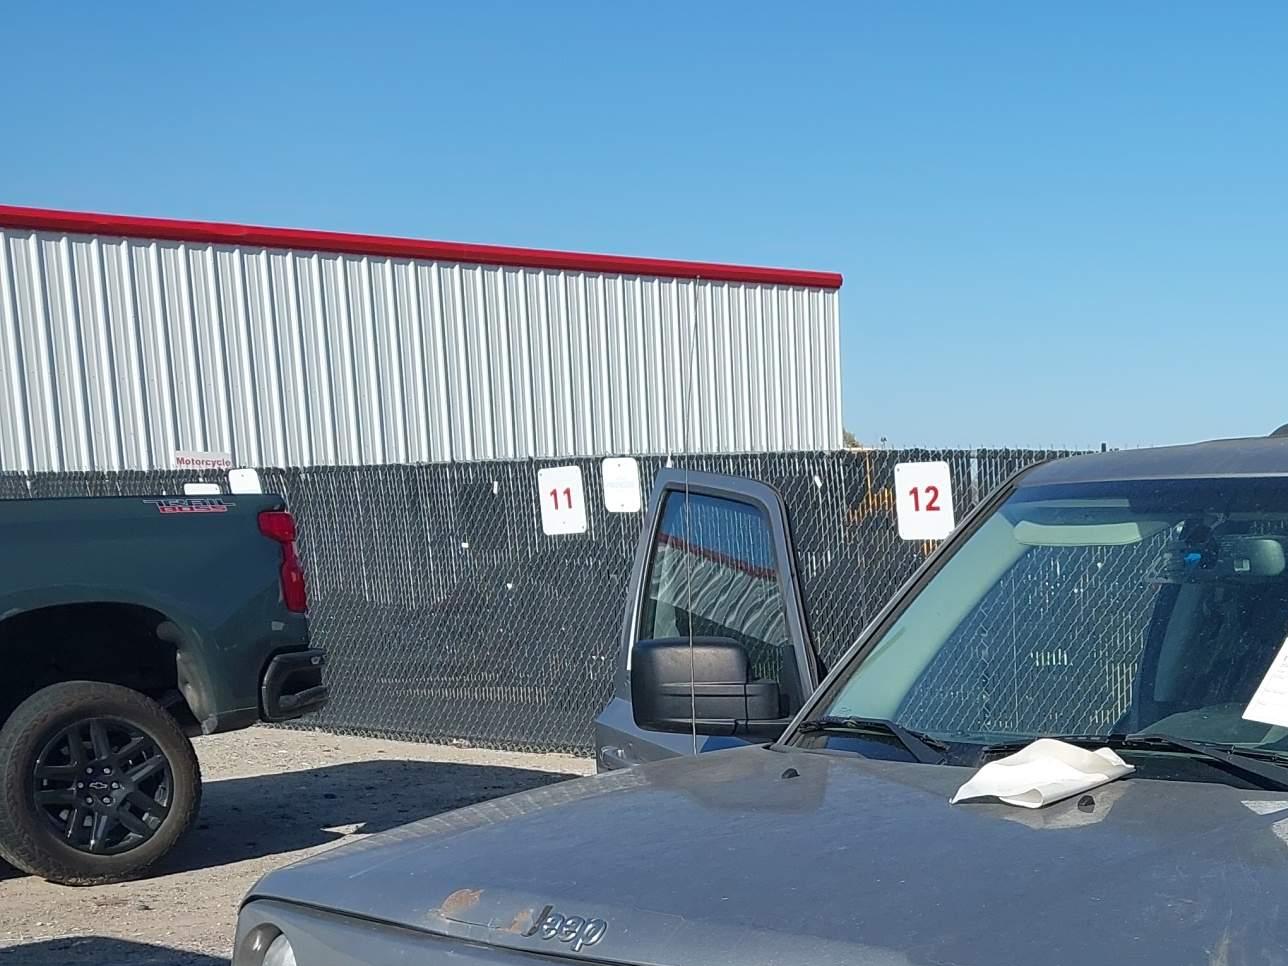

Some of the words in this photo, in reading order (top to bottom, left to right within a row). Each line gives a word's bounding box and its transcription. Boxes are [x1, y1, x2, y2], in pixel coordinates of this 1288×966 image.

[550, 487, 572, 511] 11
[909, 485, 941, 512] 12
[521, 905, 608, 952] Jeep
